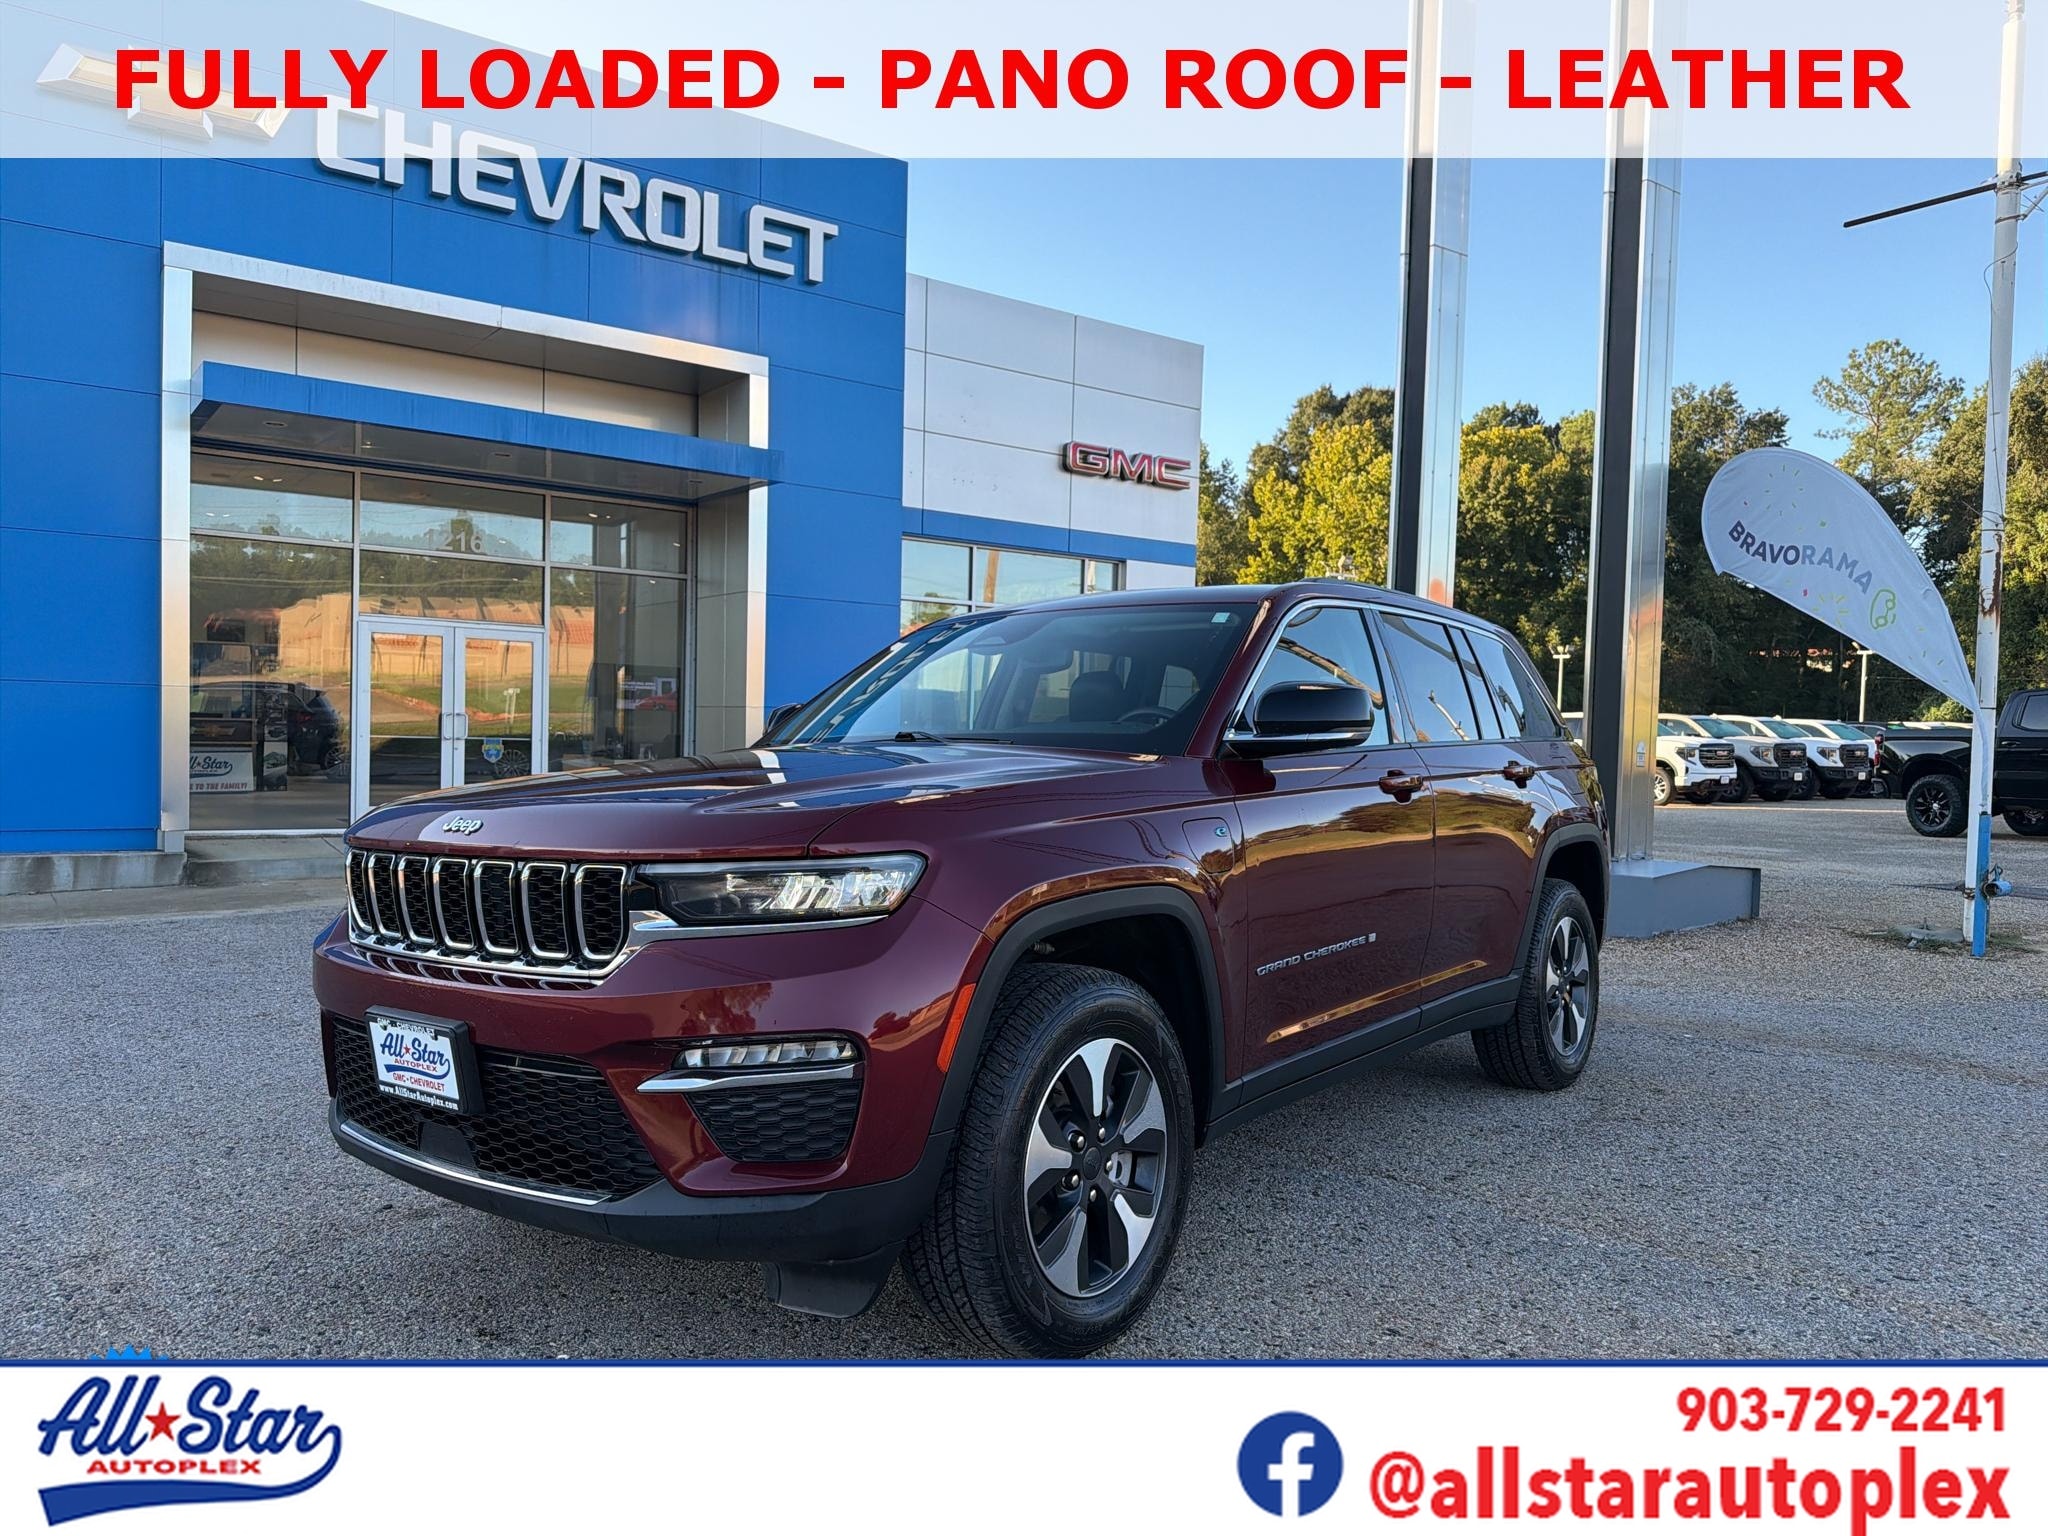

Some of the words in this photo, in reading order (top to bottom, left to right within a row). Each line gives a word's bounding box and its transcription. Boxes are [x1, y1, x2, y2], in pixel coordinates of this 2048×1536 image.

[316, 93, 839, 285] CHEVROLET
[1062, 441, 1191, 490] GMC
[423, 527, 484, 554] 1216
[1728, 519, 1873, 595] BRAVORAMA
[202, 755, 233, 770] Star
[442, 816, 484, 836] Jeep
[1256, 954, 1301, 976] GRAND
[1303, 935, 1367, 961] CHEROKEE
[380, 1032, 405, 1059] All
[411, 1037, 450, 1067] Star
[393, 1058, 438, 1073] AUTOPLEX
[392, 1072, 407, 1083] GMC
[409, 1076, 446, 1093] CHEVROLET
